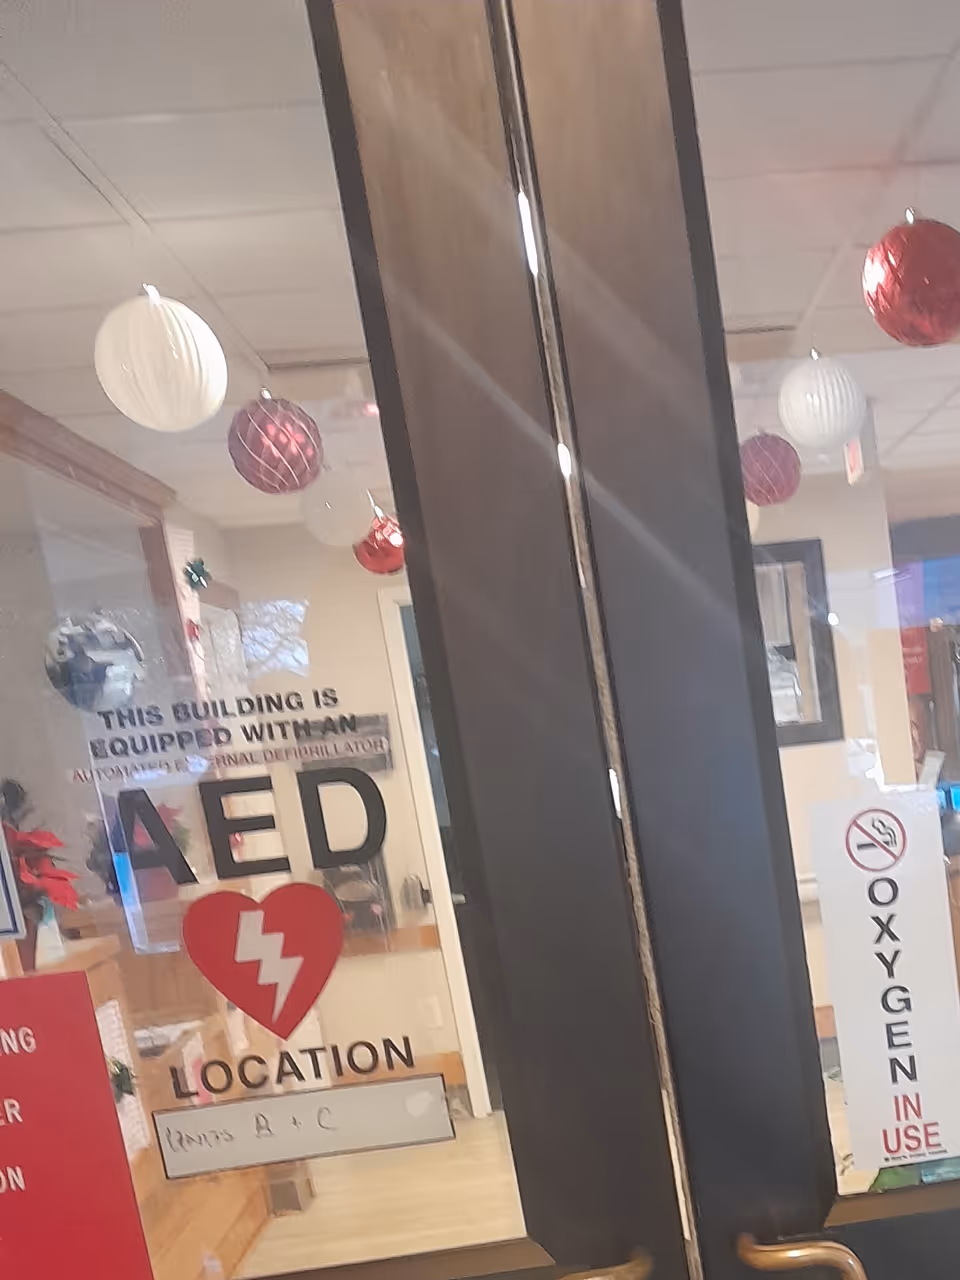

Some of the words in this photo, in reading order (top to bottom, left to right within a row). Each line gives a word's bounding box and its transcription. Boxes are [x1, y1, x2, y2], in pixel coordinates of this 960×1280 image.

[97, 704, 164, 730] THIS
[172, 690, 304, 722] BUILDING
[314, 688, 339, 709] IS
[89, 727, 232, 760] EQUIPPED
[240, 721, 311, 744] WITH
[320, 714, 357, 734] AN
[175, 750, 258, 774] EERNAL
[263, 737, 386, 762] DEFIBRILLATOR
[112, 766, 387, 888] AED
[867, 876, 920, 1086] OXYGEN
[0, 1026, 36, 1056] NG
[169, 1036, 415, 1098] LOCATION
[317, 1106, 336, 1130] C
[894, 1093, 922, 1122] IN
[882, 1122, 941, 1155] USE
